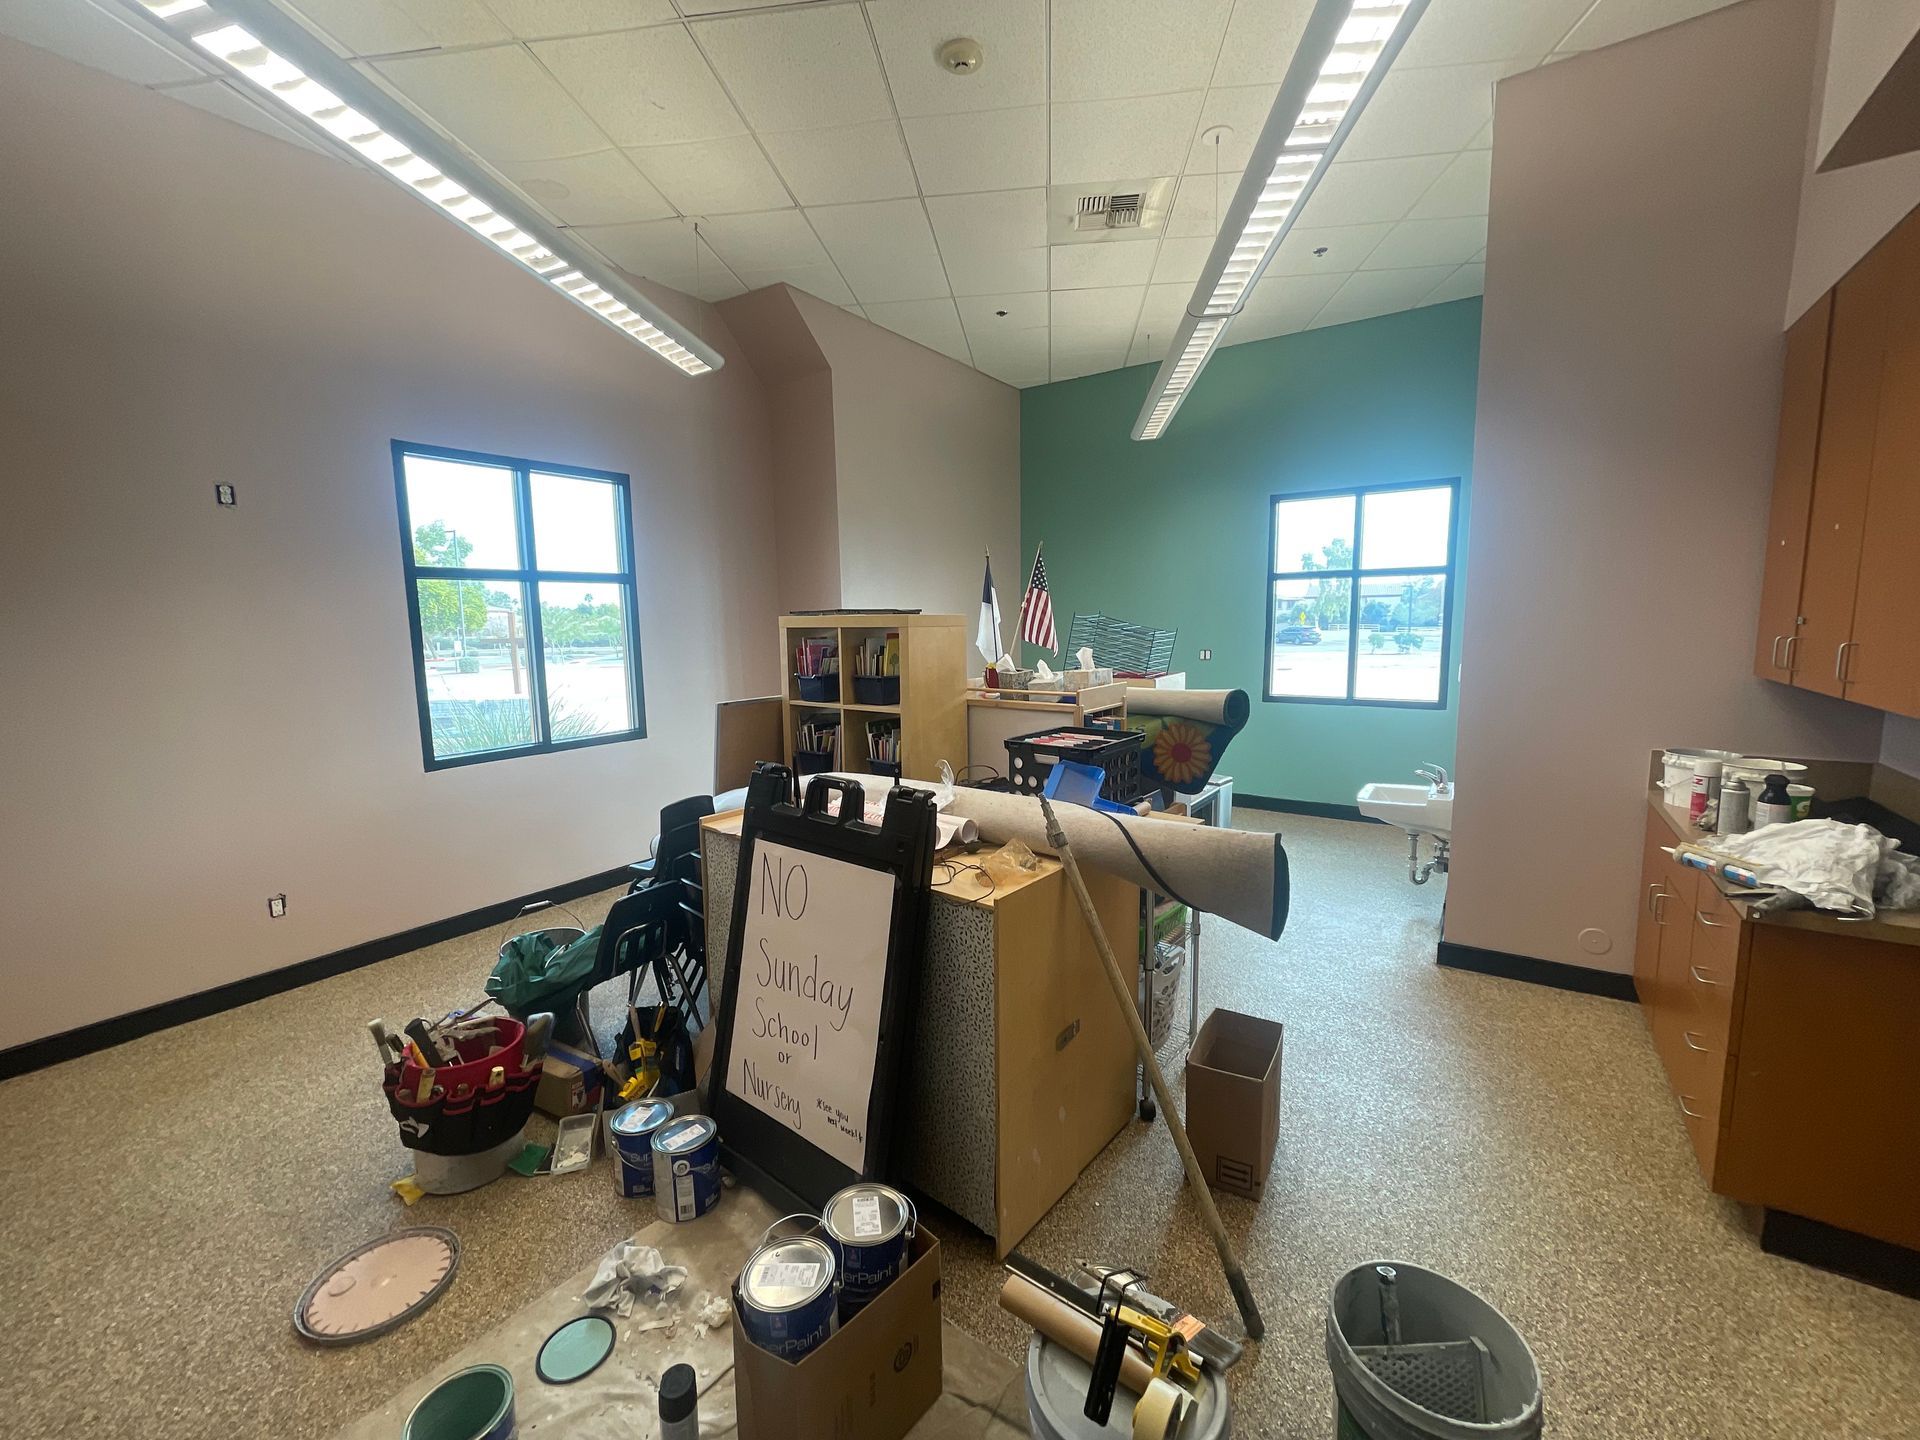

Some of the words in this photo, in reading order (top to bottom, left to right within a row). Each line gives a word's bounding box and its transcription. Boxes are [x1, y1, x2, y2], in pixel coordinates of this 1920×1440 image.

[761, 852, 808, 921] NO
[756, 937, 854, 1031] Sunday
[752, 996, 819, 1060] School
[778, 1051, 793, 1064] or
[743, 1058, 802, 1129] Nursery
